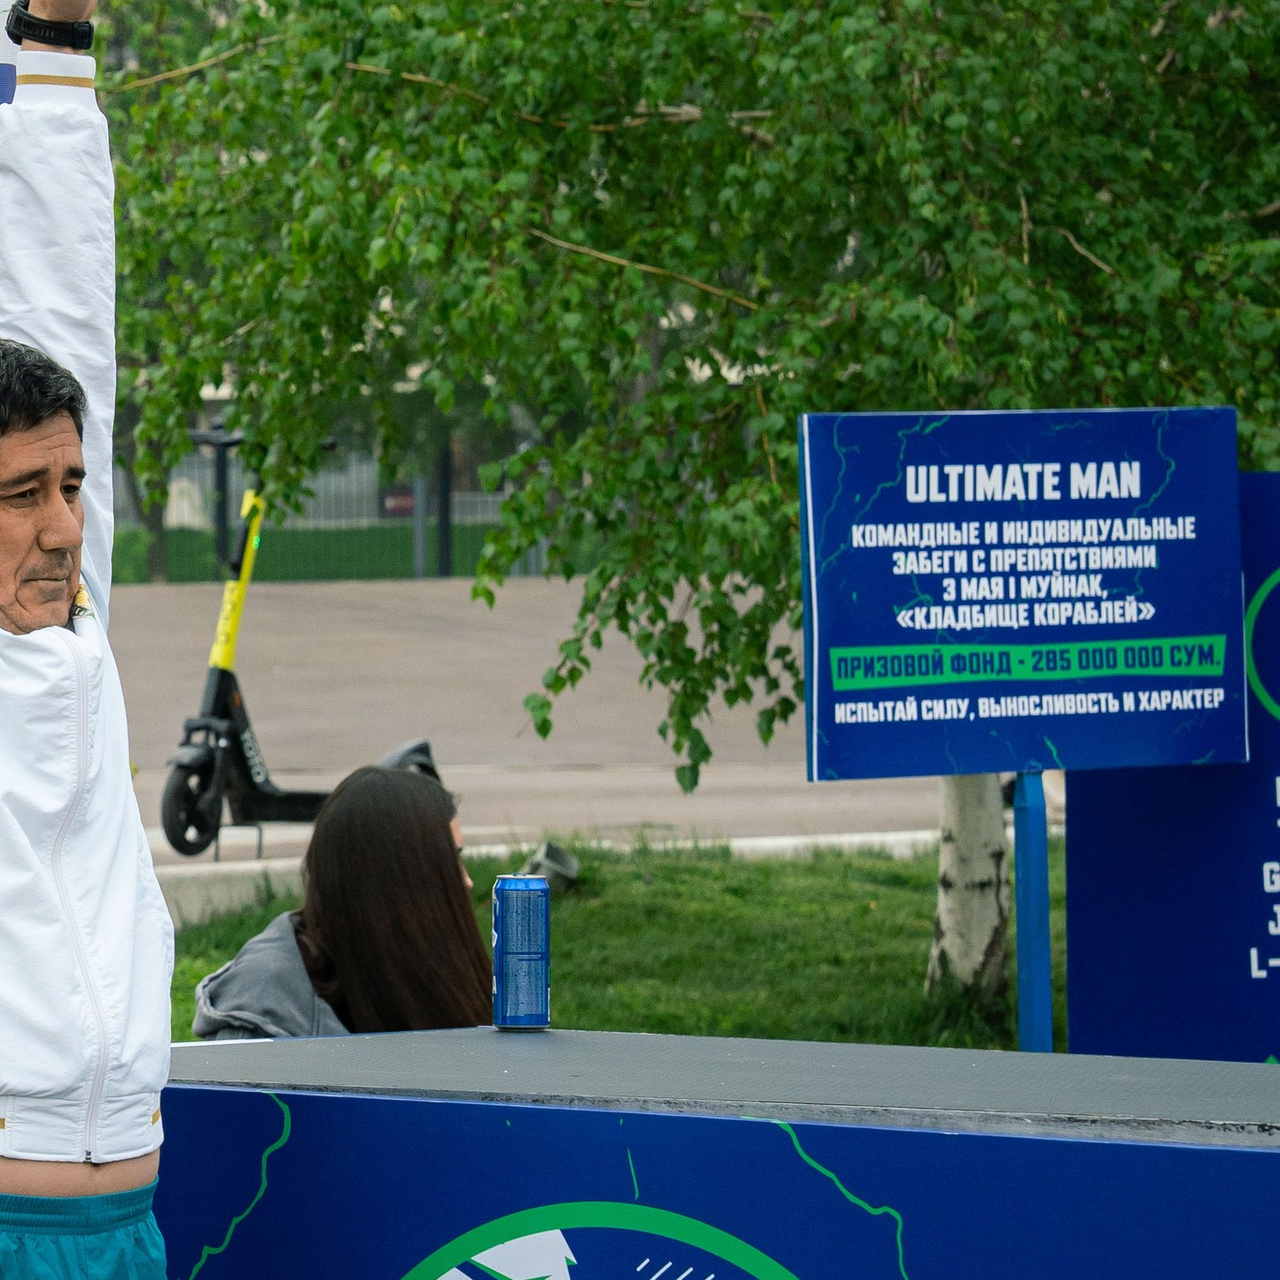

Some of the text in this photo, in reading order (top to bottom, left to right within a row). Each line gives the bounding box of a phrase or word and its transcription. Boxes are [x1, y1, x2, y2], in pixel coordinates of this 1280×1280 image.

[906, 461, 1141, 503] ULTIMATE MAN
[851, 516, 1196, 549] КОМАНДНЫЕ И ИНДИВИДУАЛЬНЫЕ
[892, 545, 1157, 575] ЗАБЕГИ С ПРЕПЯТСТВИЯМИ
[960, 576, 1004, 601] МАЯ
[1020, 570, 1108, 600] МУЙНАК,
[896, 595, 1156, 631] «КЛАДБИЩЕ КОРАБЛЕЙ»
[836, 648, 944, 679] ПРИЗОВОЙ
[950, 650, 1012, 676] ФОНД
[1031, 649, 1071, 672] 285
[1077, 647, 1118, 671] 000
[1123, 646, 1164, 669] 000
[1170, 643, 1220, 668] СУМ.
[834, 687, 1225, 724] ИСПЫТАЙ СИЛУ, ВЫНОСЛИВОСТЬ И ХАРАКТЕР
